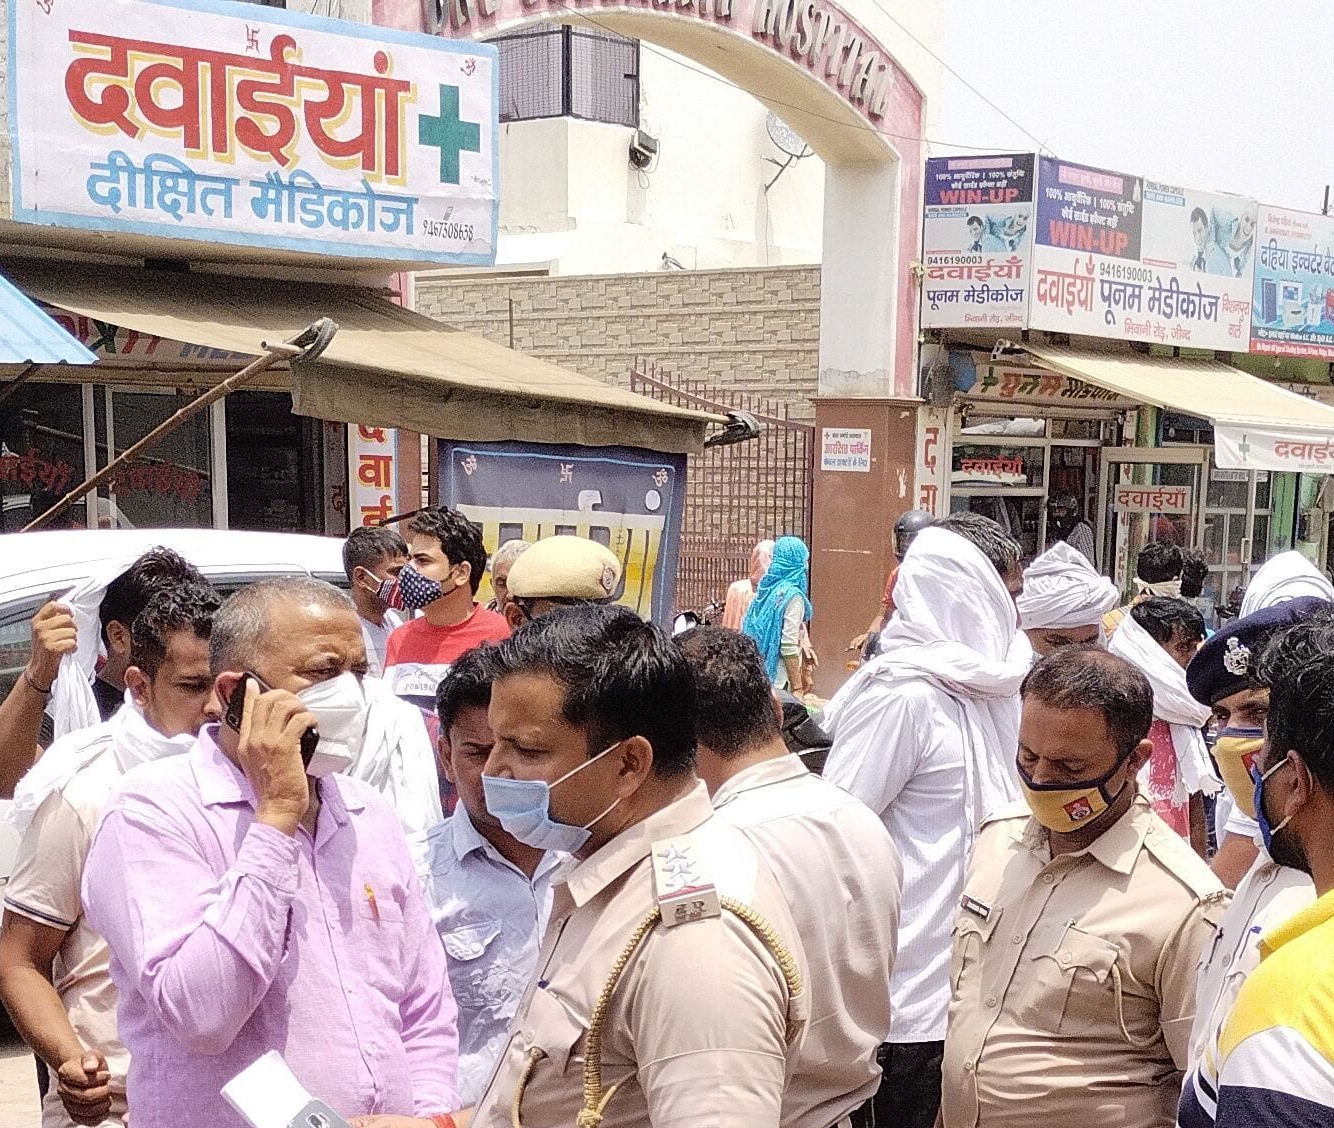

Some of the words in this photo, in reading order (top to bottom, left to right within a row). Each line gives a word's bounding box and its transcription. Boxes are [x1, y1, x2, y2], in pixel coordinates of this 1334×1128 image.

[65, 30, 415, 182] दवाईयां
[86, 151, 240, 221] दीक्षित
[249, 168, 419, 235] मैडिकोज
[939, 188, 1019, 204] WIN-UP
[1045, 187, 1063, 200] 100%
[1100, 197, 1116, 211] 100%
[1050, 219, 1129, 256] WIN-UP
[927, 256, 983, 264] 9416190003
[927, 256, 1024, 282] दवाईयाँ
[1099, 262, 1153, 283] 9416190003
[927, 290, 960, 311] पूनम
[964, 284, 1024, 304] मेडीकोज
[1037, 254, 1096, 316] दवाईयाँ
[1099, 279, 1144, 326] पूनम
[1148, 275, 1220, 322] मेडीकोज
